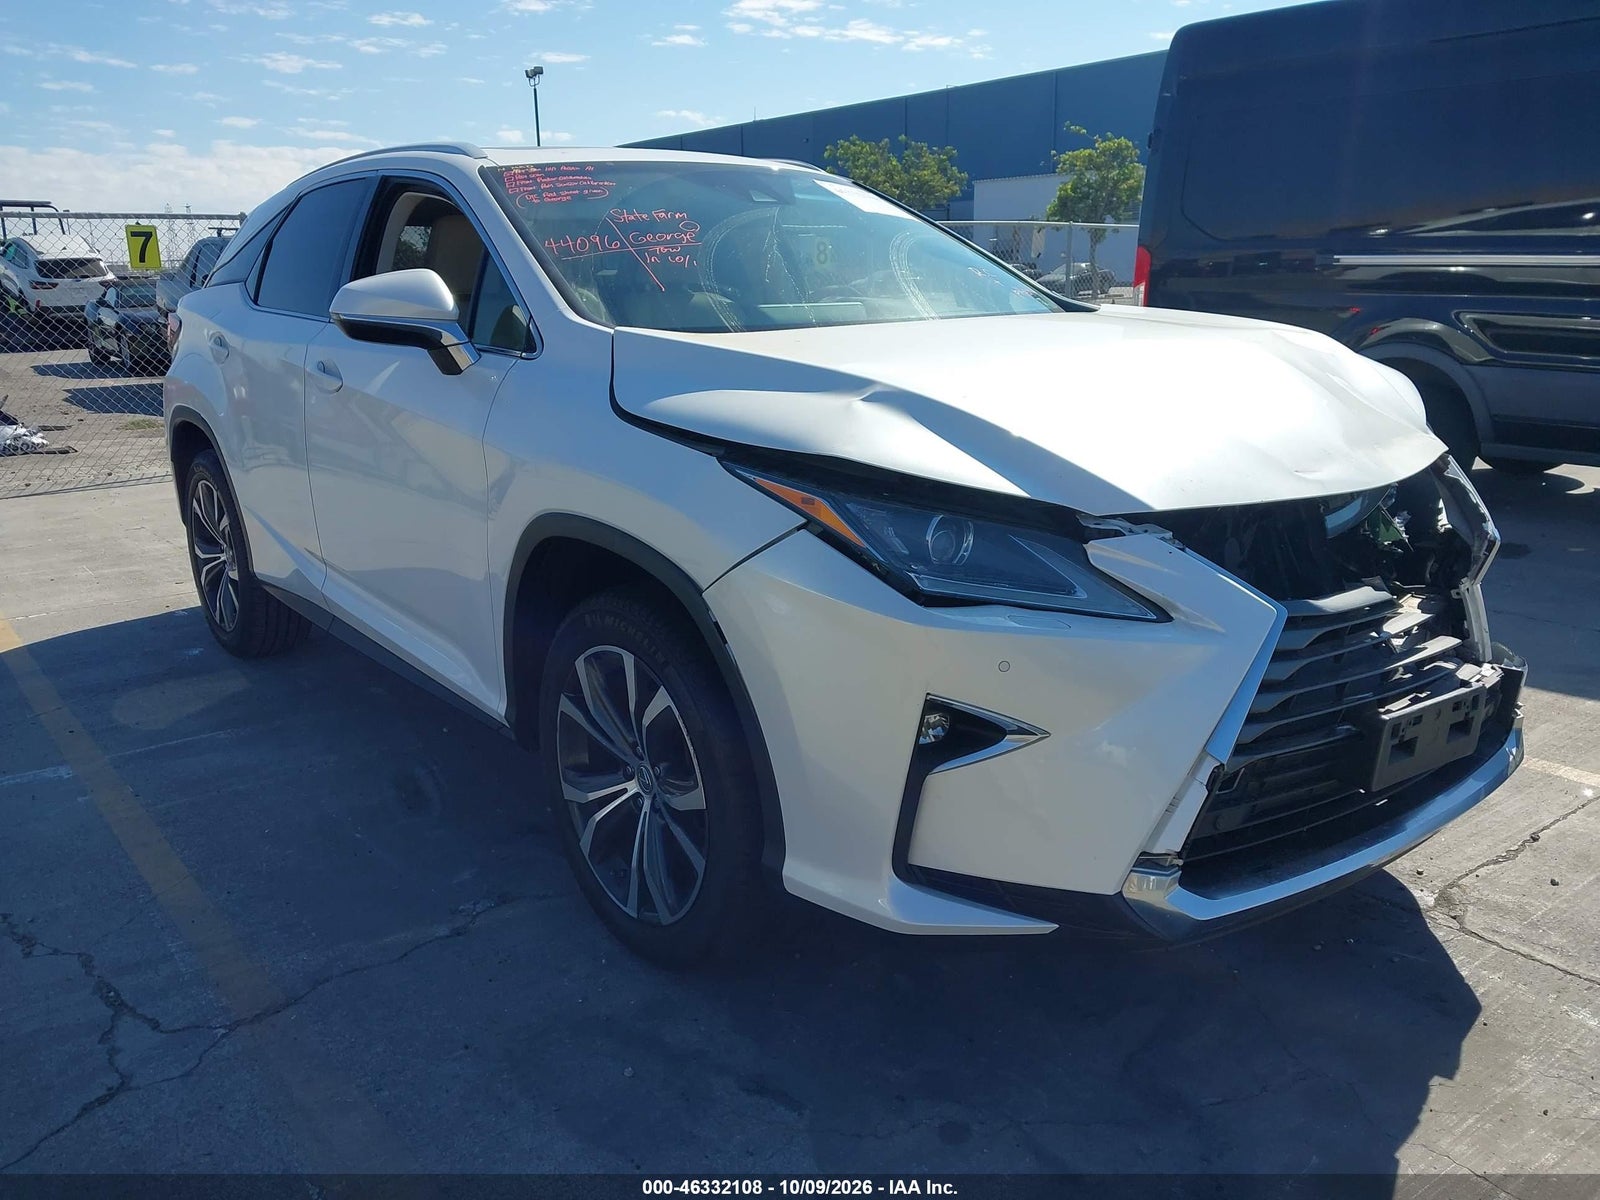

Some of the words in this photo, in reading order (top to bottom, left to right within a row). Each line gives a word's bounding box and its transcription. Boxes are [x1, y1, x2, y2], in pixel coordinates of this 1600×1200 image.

[609, 208, 649, 224] State
[651, 208, 688, 222] Farm
[130, 231, 153, 263] 7
[544, 234, 621, 255] 44096
[629, 230, 697, 243] George
[816, 240, 828, 265] 8
